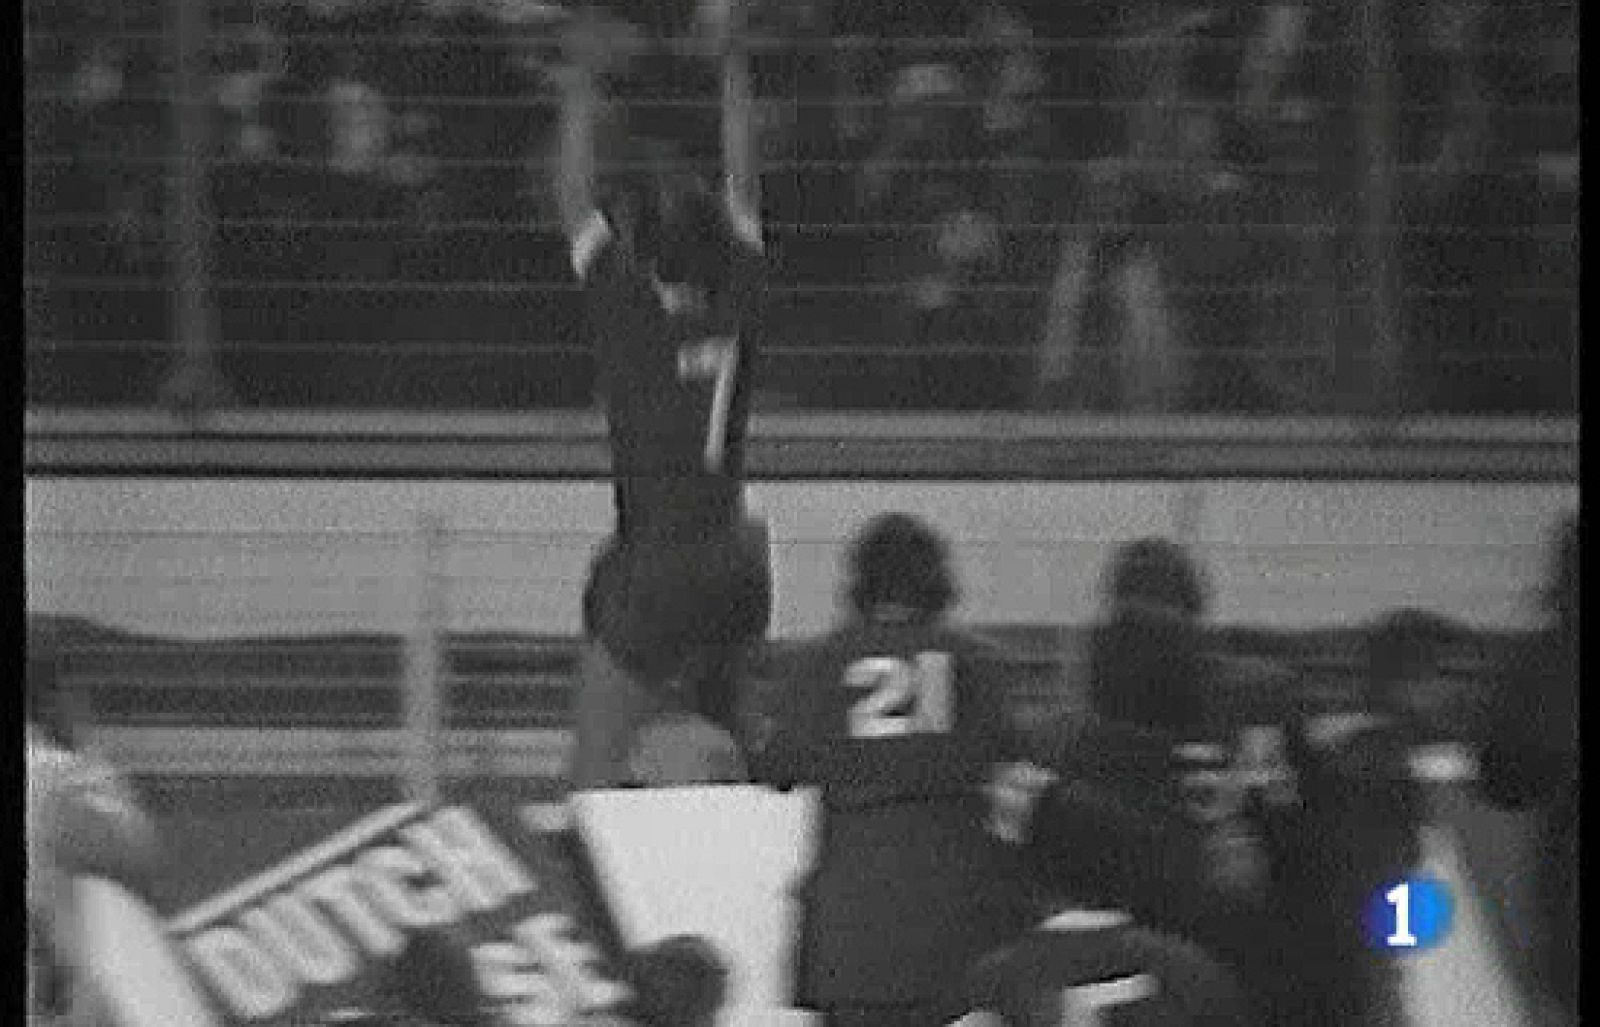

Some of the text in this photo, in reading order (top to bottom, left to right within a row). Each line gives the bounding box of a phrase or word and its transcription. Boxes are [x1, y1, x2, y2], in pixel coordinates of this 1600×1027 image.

[678, 337, 739, 473] 7
[843, 652, 953, 738] 21
[187, 803, 535, 1019] DUTCH
